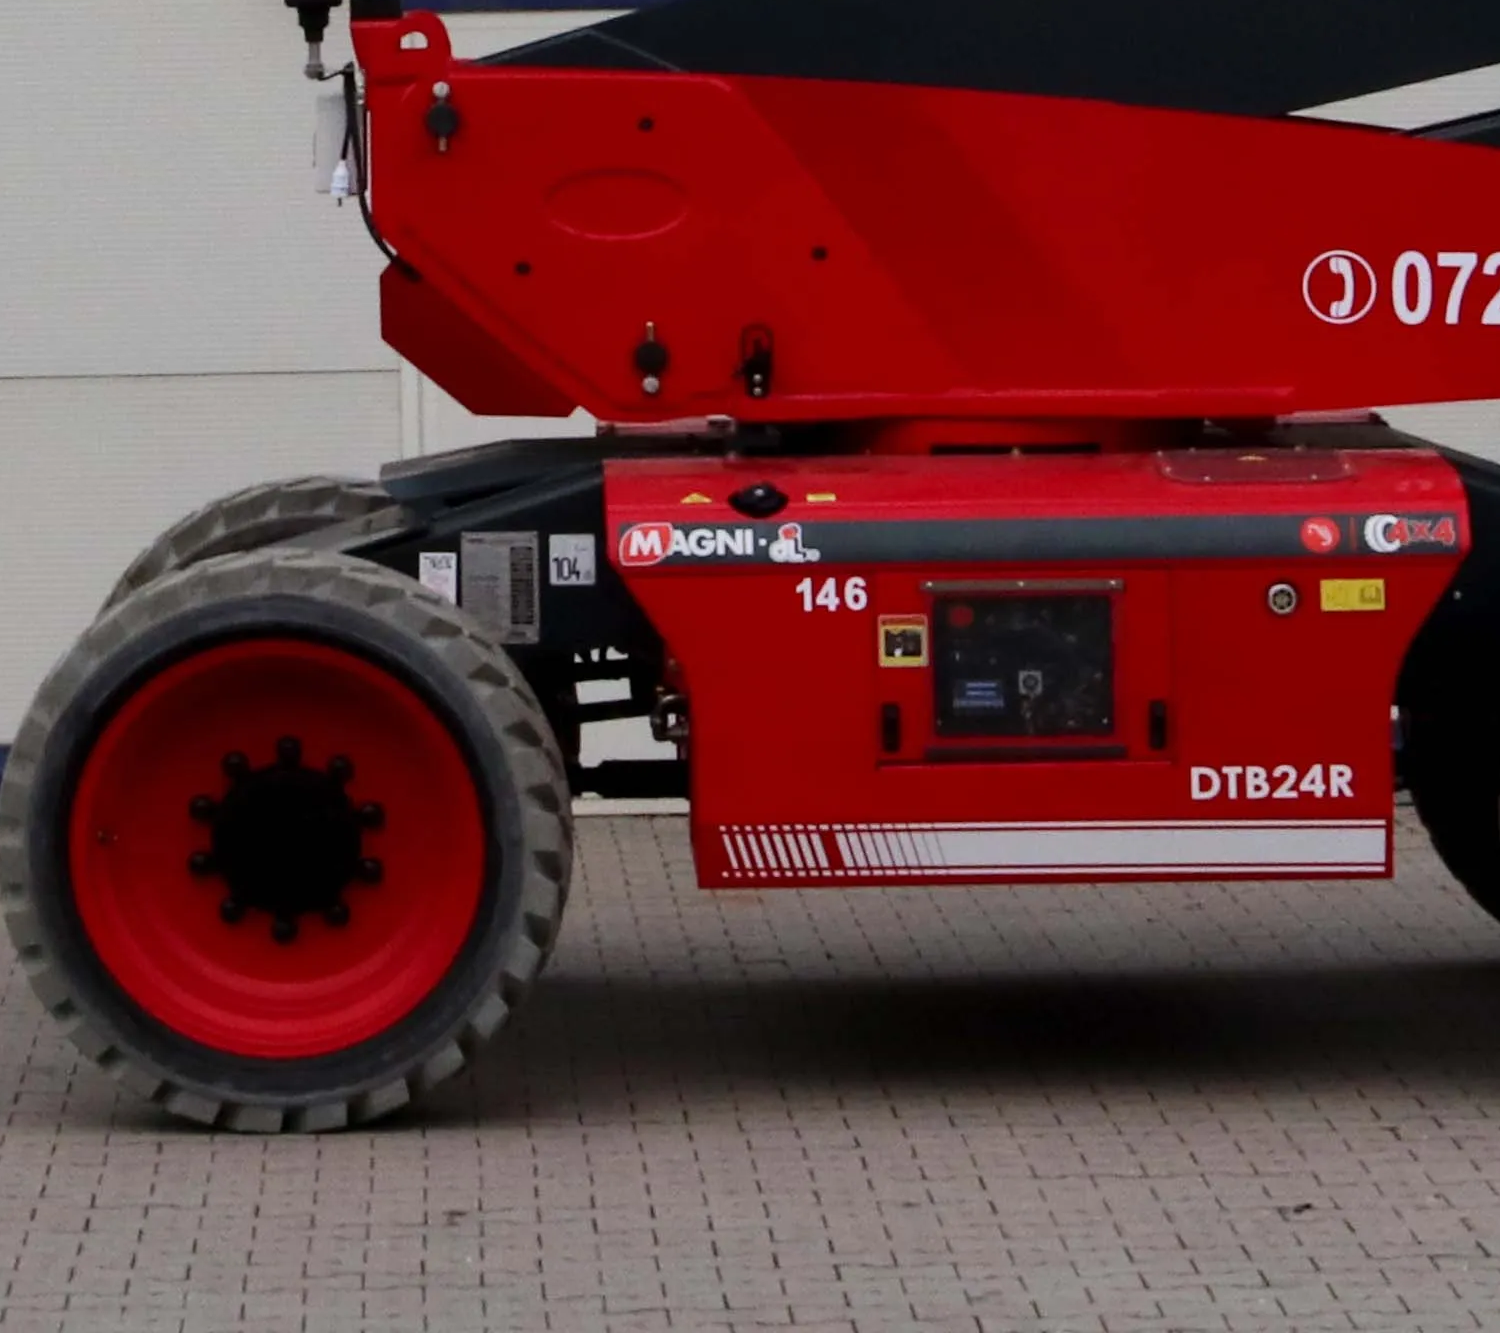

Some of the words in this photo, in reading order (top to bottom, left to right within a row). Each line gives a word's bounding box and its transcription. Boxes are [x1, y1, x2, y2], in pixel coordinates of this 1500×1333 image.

[626, 526, 754, 559] MAGNI
[551, 556, 580, 582] 104
[795, 576, 868, 612] 146
[1190, 763, 1354, 801] DTB24R
